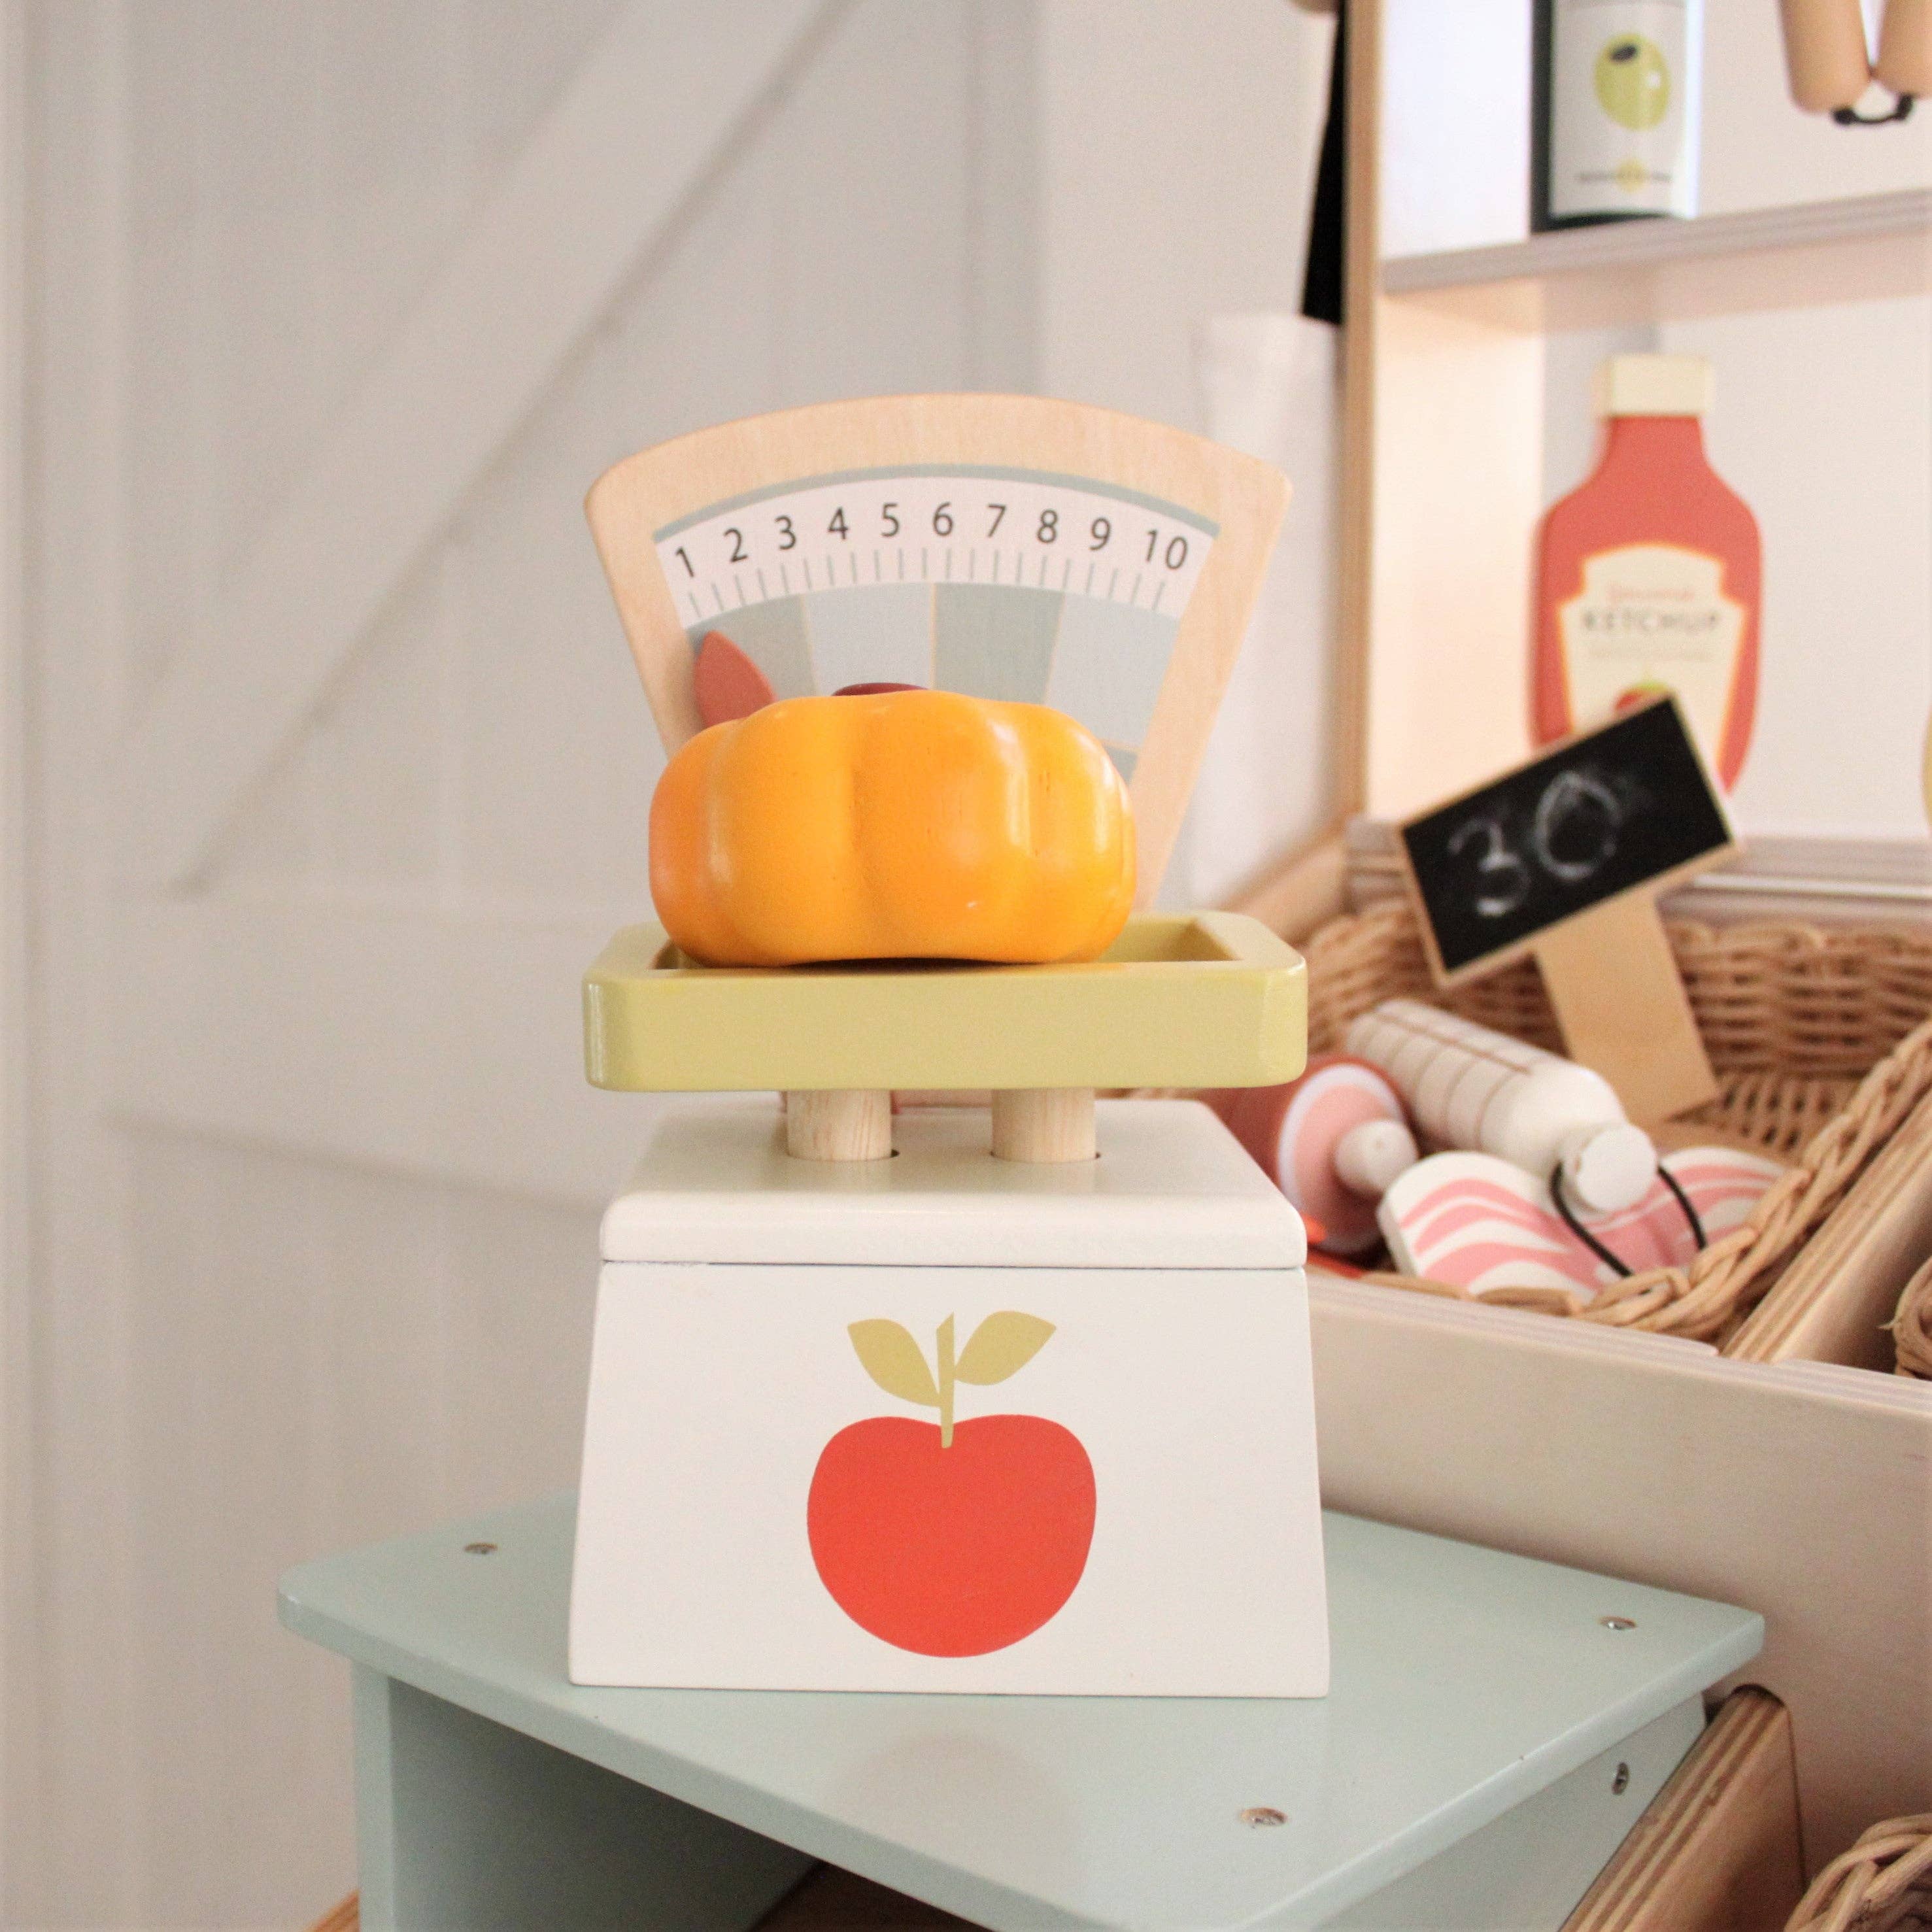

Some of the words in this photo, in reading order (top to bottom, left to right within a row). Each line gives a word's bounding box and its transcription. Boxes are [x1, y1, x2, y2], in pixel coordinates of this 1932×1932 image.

[676, 547, 694, 577] 1
[724, 528, 748, 563] 2
[775, 515, 796, 551] 3
[828, 507, 849, 540] 4
[881, 502, 900, 537] 5
[933, 501, 953, 537] 6
[987, 503, 1006, 537] 7
[1037, 509, 1059, 544] 8
[1091, 517, 1111, 551] 9
[1145, 529, 1189, 570] 10
[1448, 769, 1623, 917] 30
